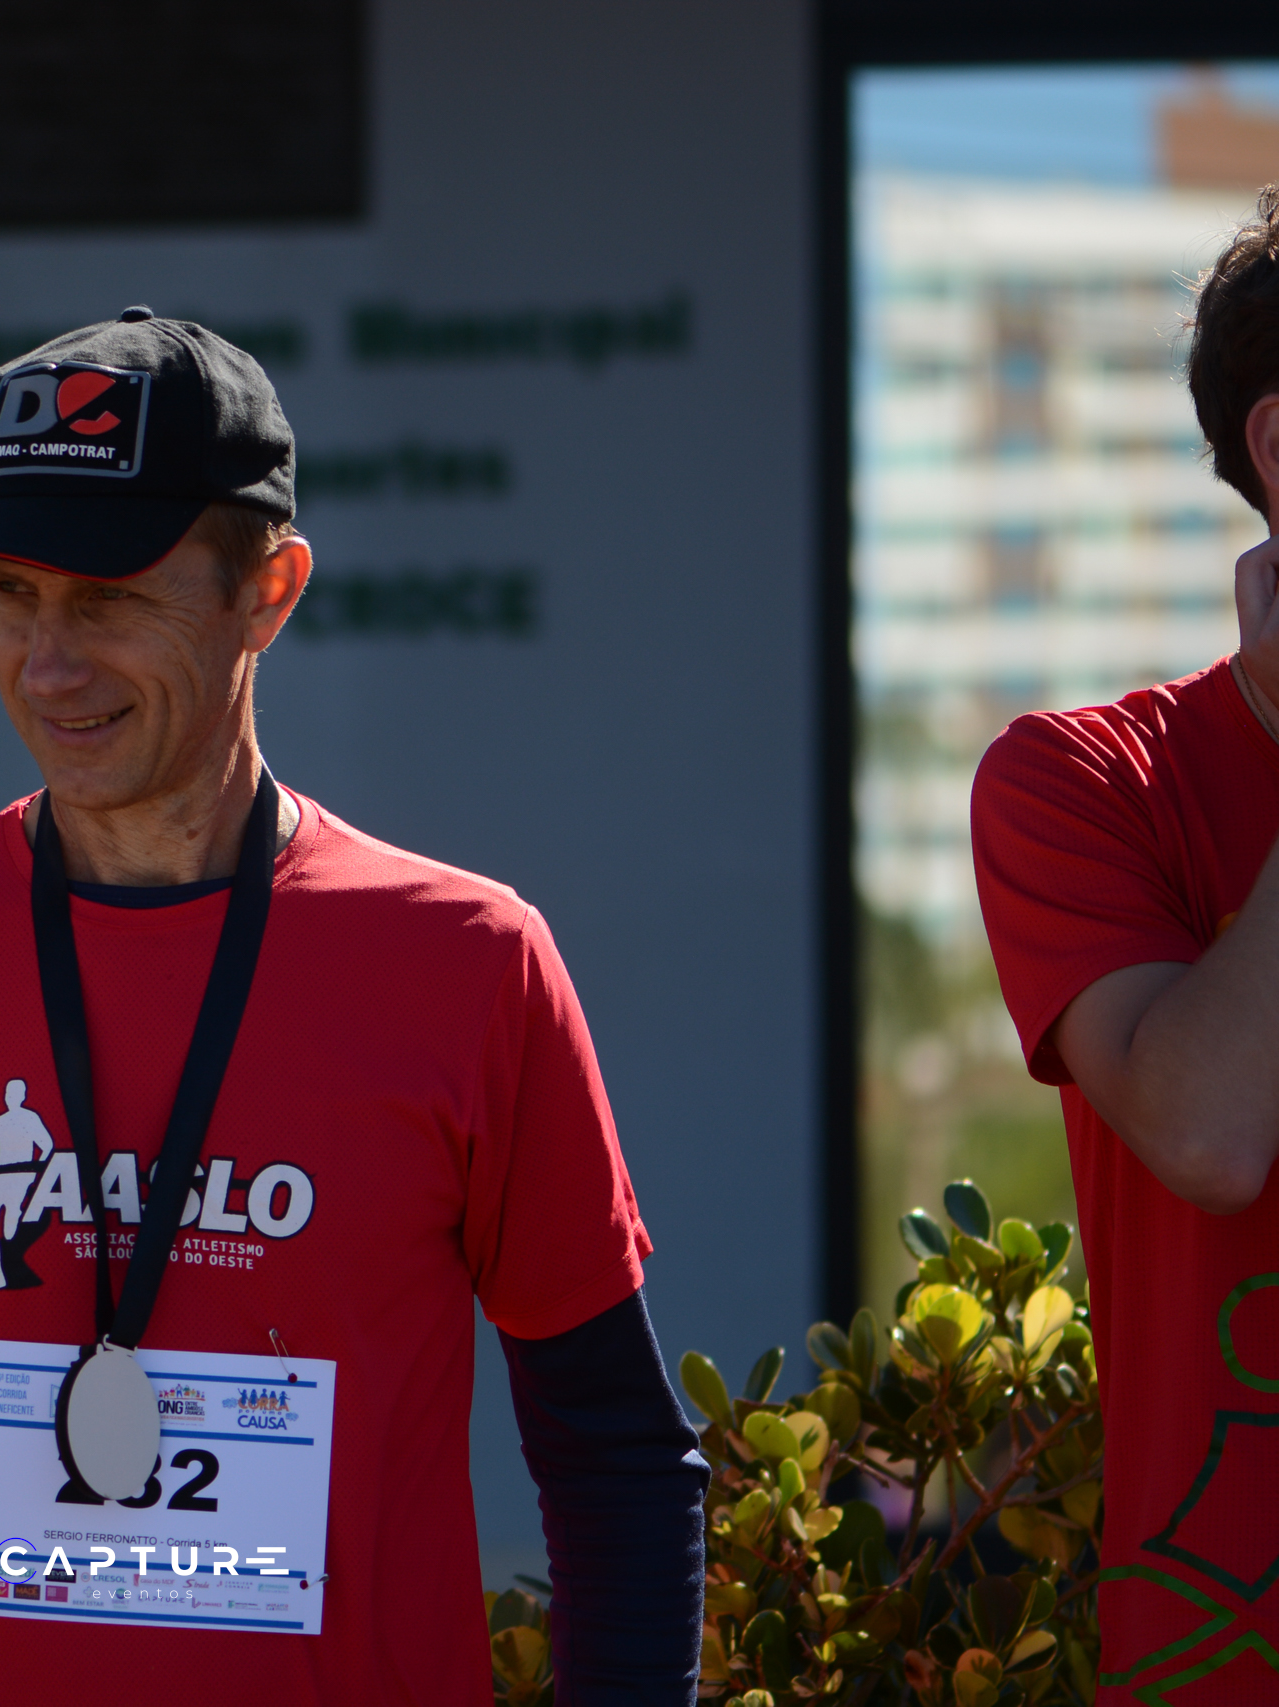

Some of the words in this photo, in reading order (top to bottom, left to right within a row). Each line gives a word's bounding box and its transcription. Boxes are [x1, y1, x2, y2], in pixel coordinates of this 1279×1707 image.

[30, 442, 117, 460] CAMPOTRAT
[182, 1237, 264, 1257] ATLETISMO
[185, 1251, 203, 1264] DO
[208, 1254, 254, 1270] OESTE
[5, 1373, 31, 1386] EDIÇÃO
[158, 1399, 184, 1415] ONG
[237, 1415, 288, 1430] CAUSA
[43, 1529, 83, 1541] SERGIO
[85, 1532, 158, 1546] FERRONATTO
[166, 1537, 202, 1549] Corrida
[204, 1539, 211, 1549] 5
[92, 1574, 127, 1584] CRESOL
